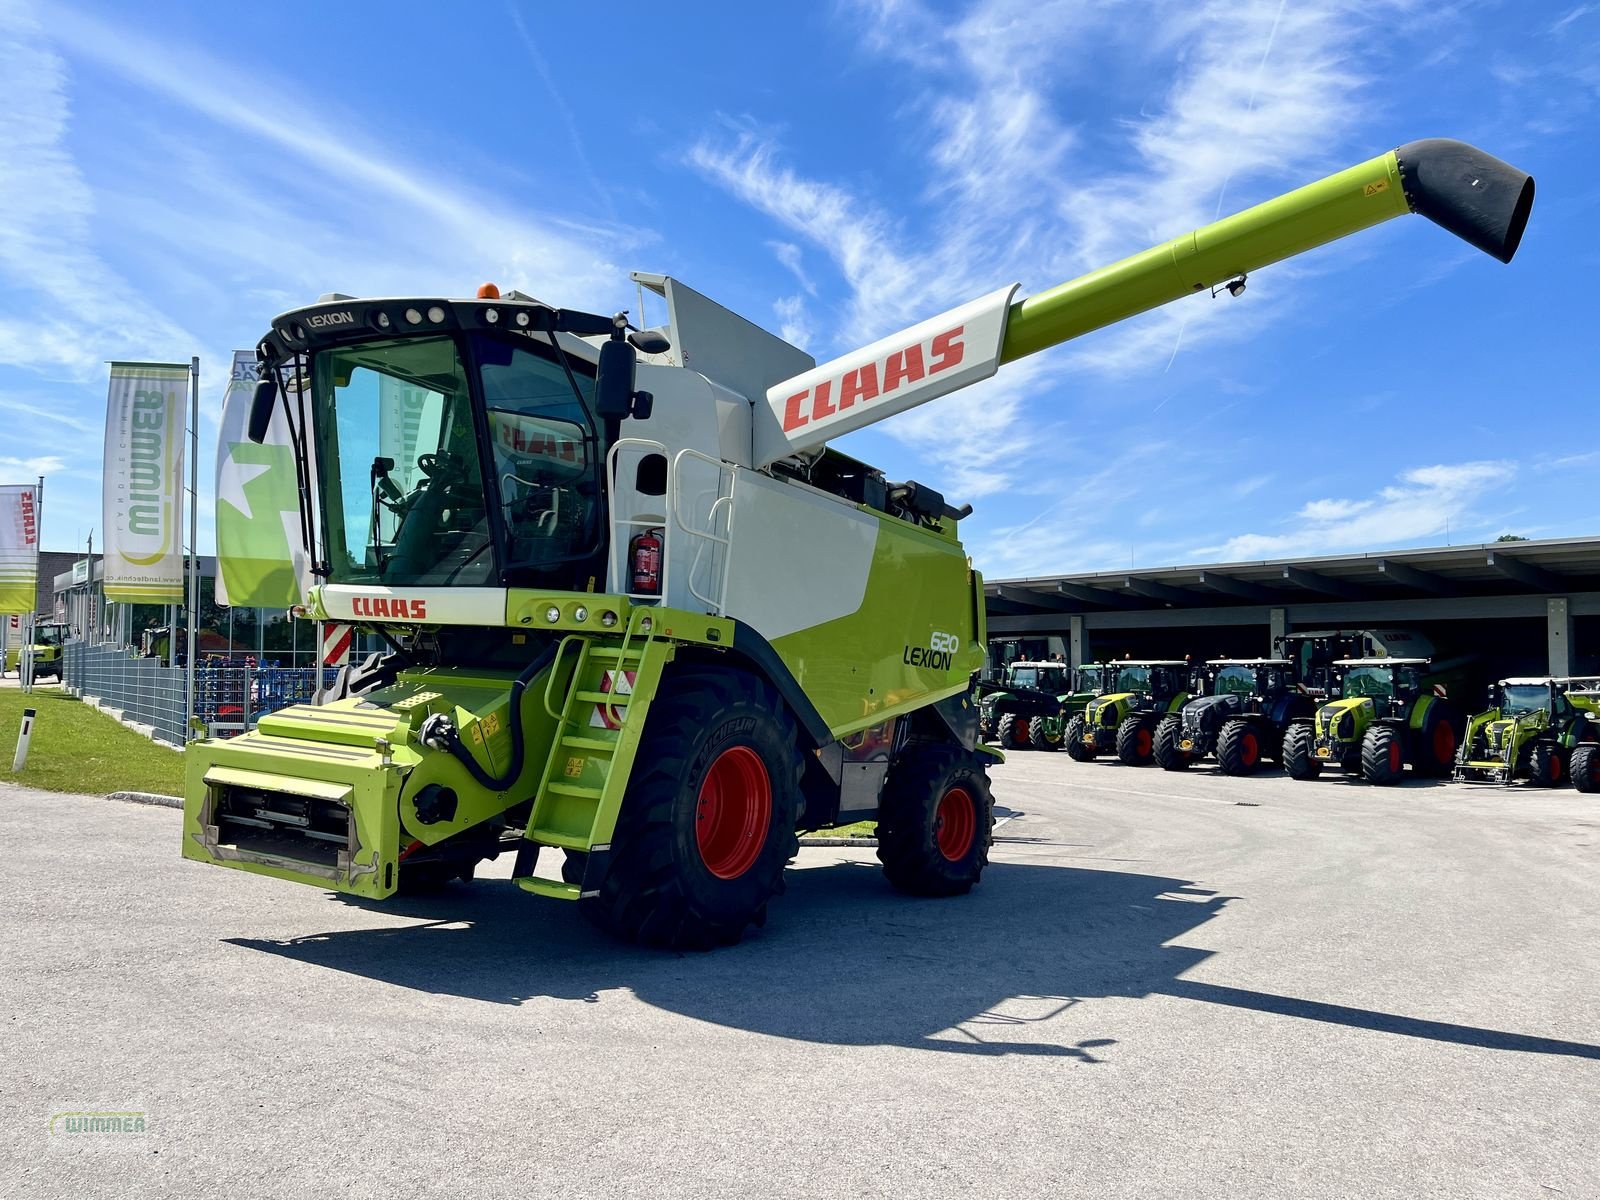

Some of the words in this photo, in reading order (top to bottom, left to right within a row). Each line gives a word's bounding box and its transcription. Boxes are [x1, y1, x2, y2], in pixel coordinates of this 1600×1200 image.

[306, 311, 354, 328] LEXION
[784, 325, 965, 432] CLAAS
[352, 597, 426, 619] CLAAS
[930, 631, 959, 654] 620
[903, 645, 953, 671] LEXION
[699, 717, 757, 767] MICHELIN
